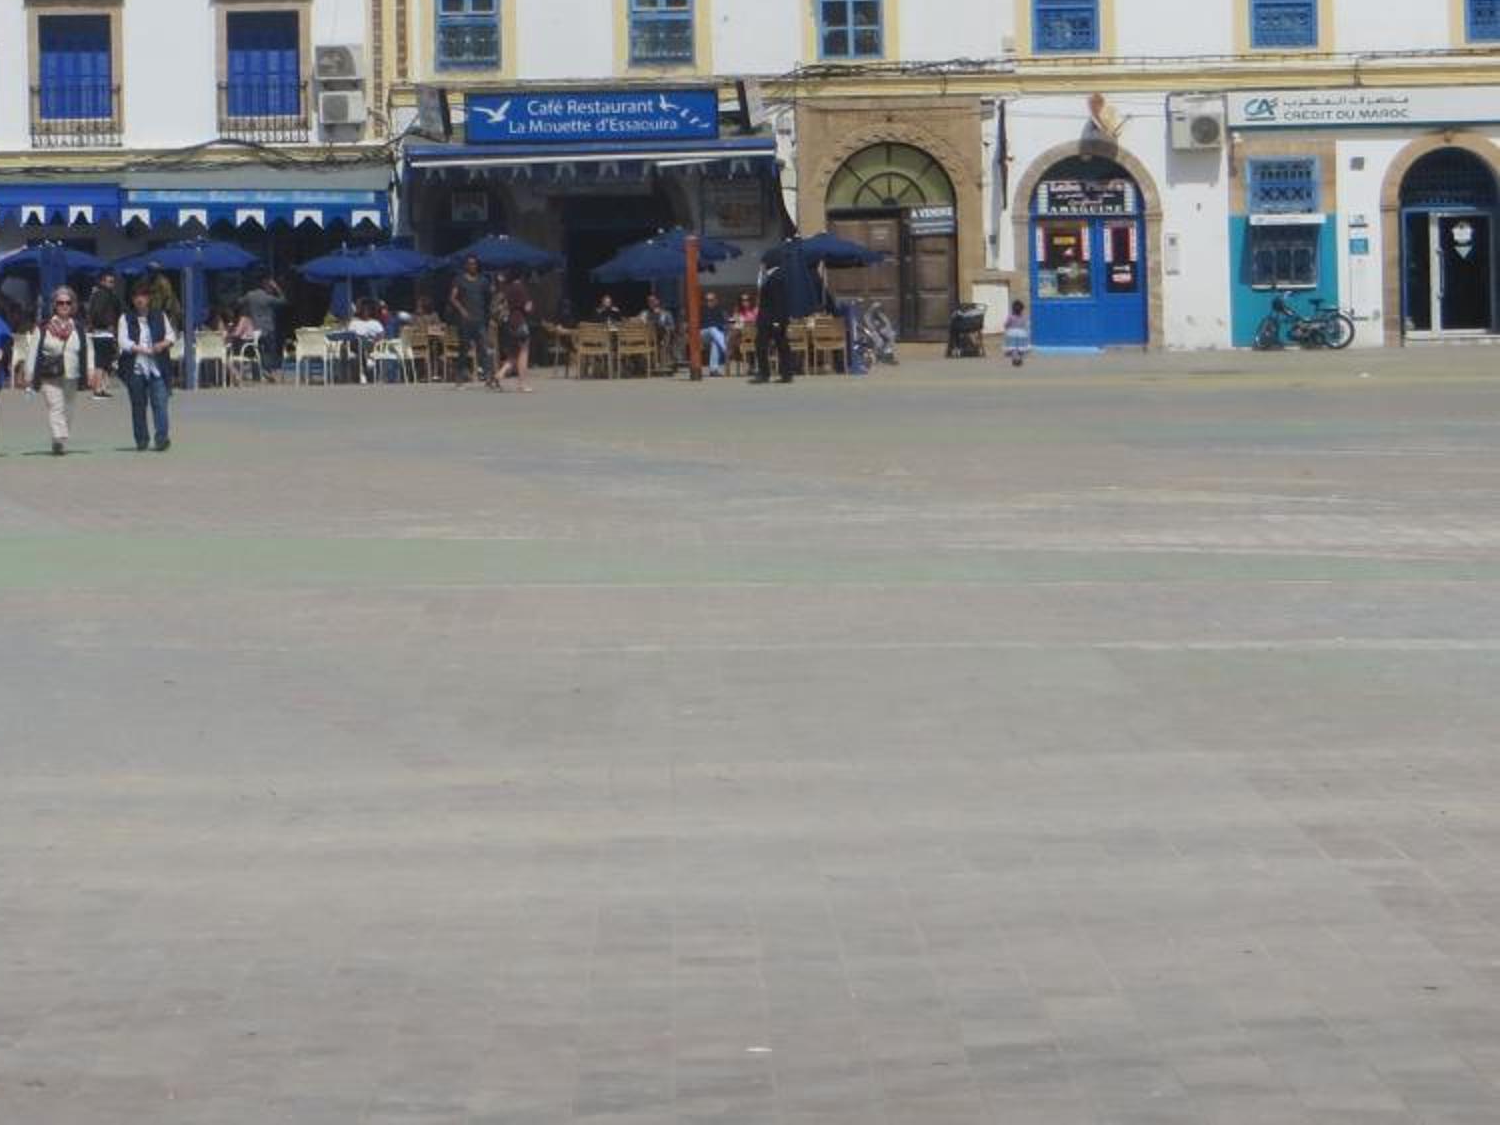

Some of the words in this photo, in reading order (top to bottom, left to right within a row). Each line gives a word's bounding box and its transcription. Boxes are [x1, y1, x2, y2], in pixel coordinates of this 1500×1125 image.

[527, 99, 563, 116] Café
[567, 99, 654, 115] Restaurant
[1336, 109, 1355, 120] DU
[1360, 108, 1409, 119] MAROC
[508, 120, 526, 134] La
[529, 119, 592, 133] Mouette
[595, 117, 678, 132] d'Essaouira
